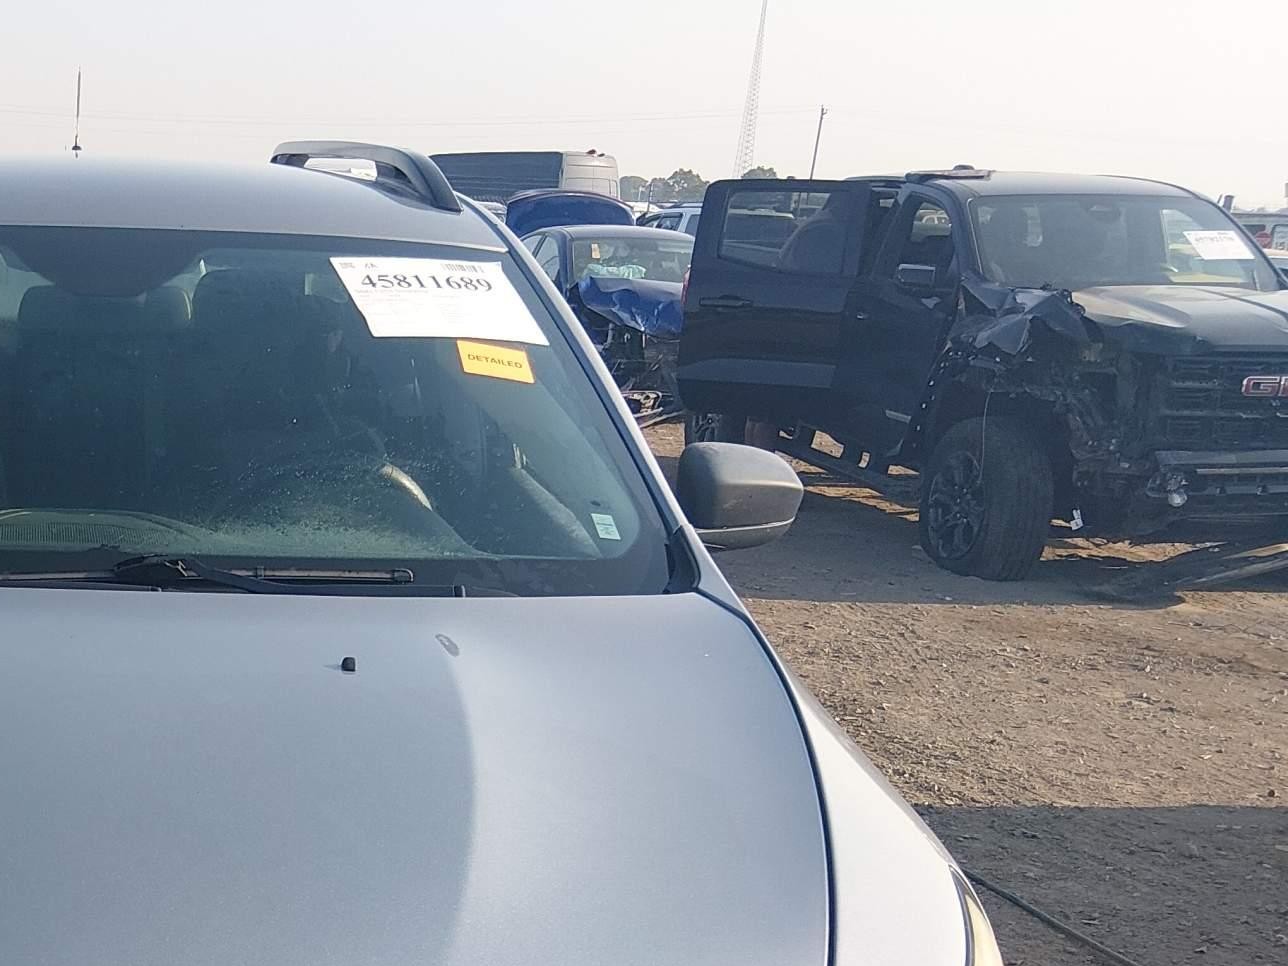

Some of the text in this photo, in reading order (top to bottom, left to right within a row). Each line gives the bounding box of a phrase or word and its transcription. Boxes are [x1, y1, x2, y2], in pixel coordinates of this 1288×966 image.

[361, 273, 493, 293] 45811689
[467, 353, 523, 369] DETAILED
[1241, 375, 1288, 397] G
